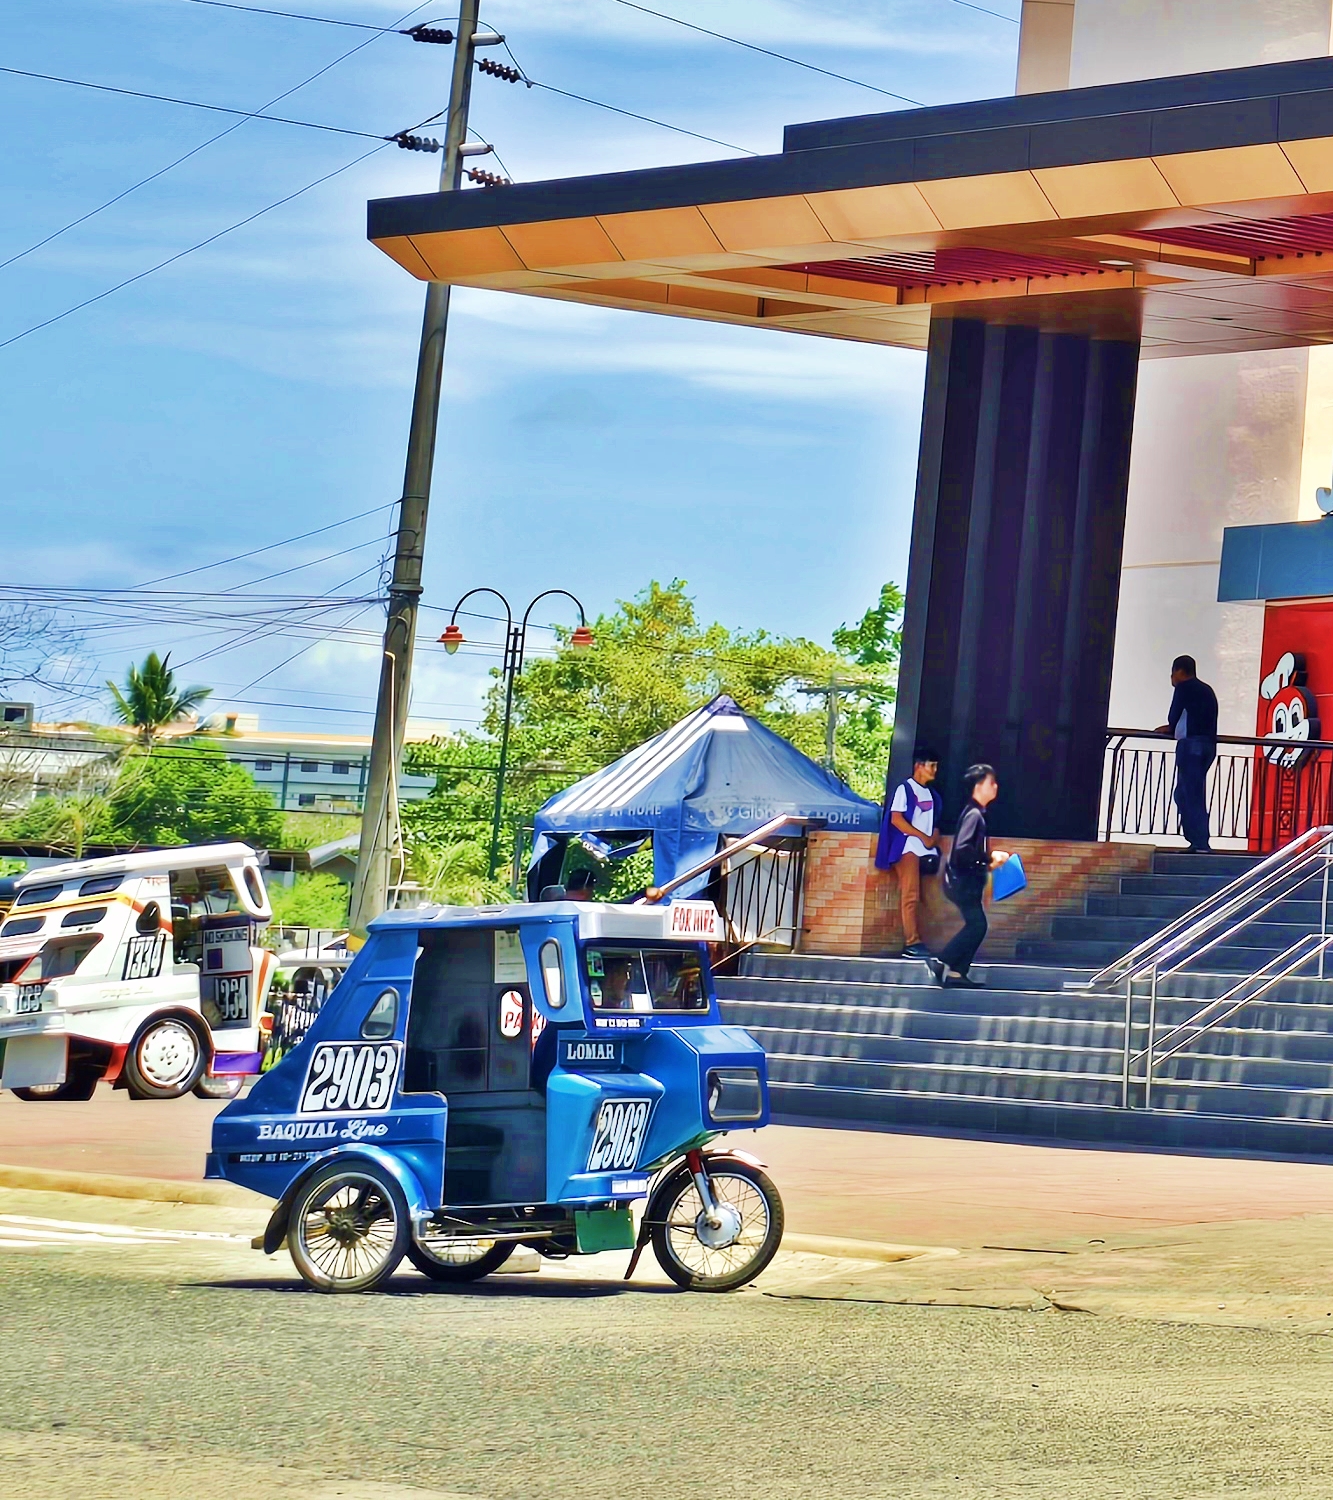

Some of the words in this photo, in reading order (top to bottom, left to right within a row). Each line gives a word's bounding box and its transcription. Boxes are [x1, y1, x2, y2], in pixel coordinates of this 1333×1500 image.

[672, 907, 692, 933] FOR
[566, 1043, 615, 1061] LOMAR
[302, 1045, 399, 1112] 2903
[257, 1121, 338, 1141] BAQUIAL
[340, 1119, 388, 1140] Line
[588, 1102, 648, 1171] 2903
